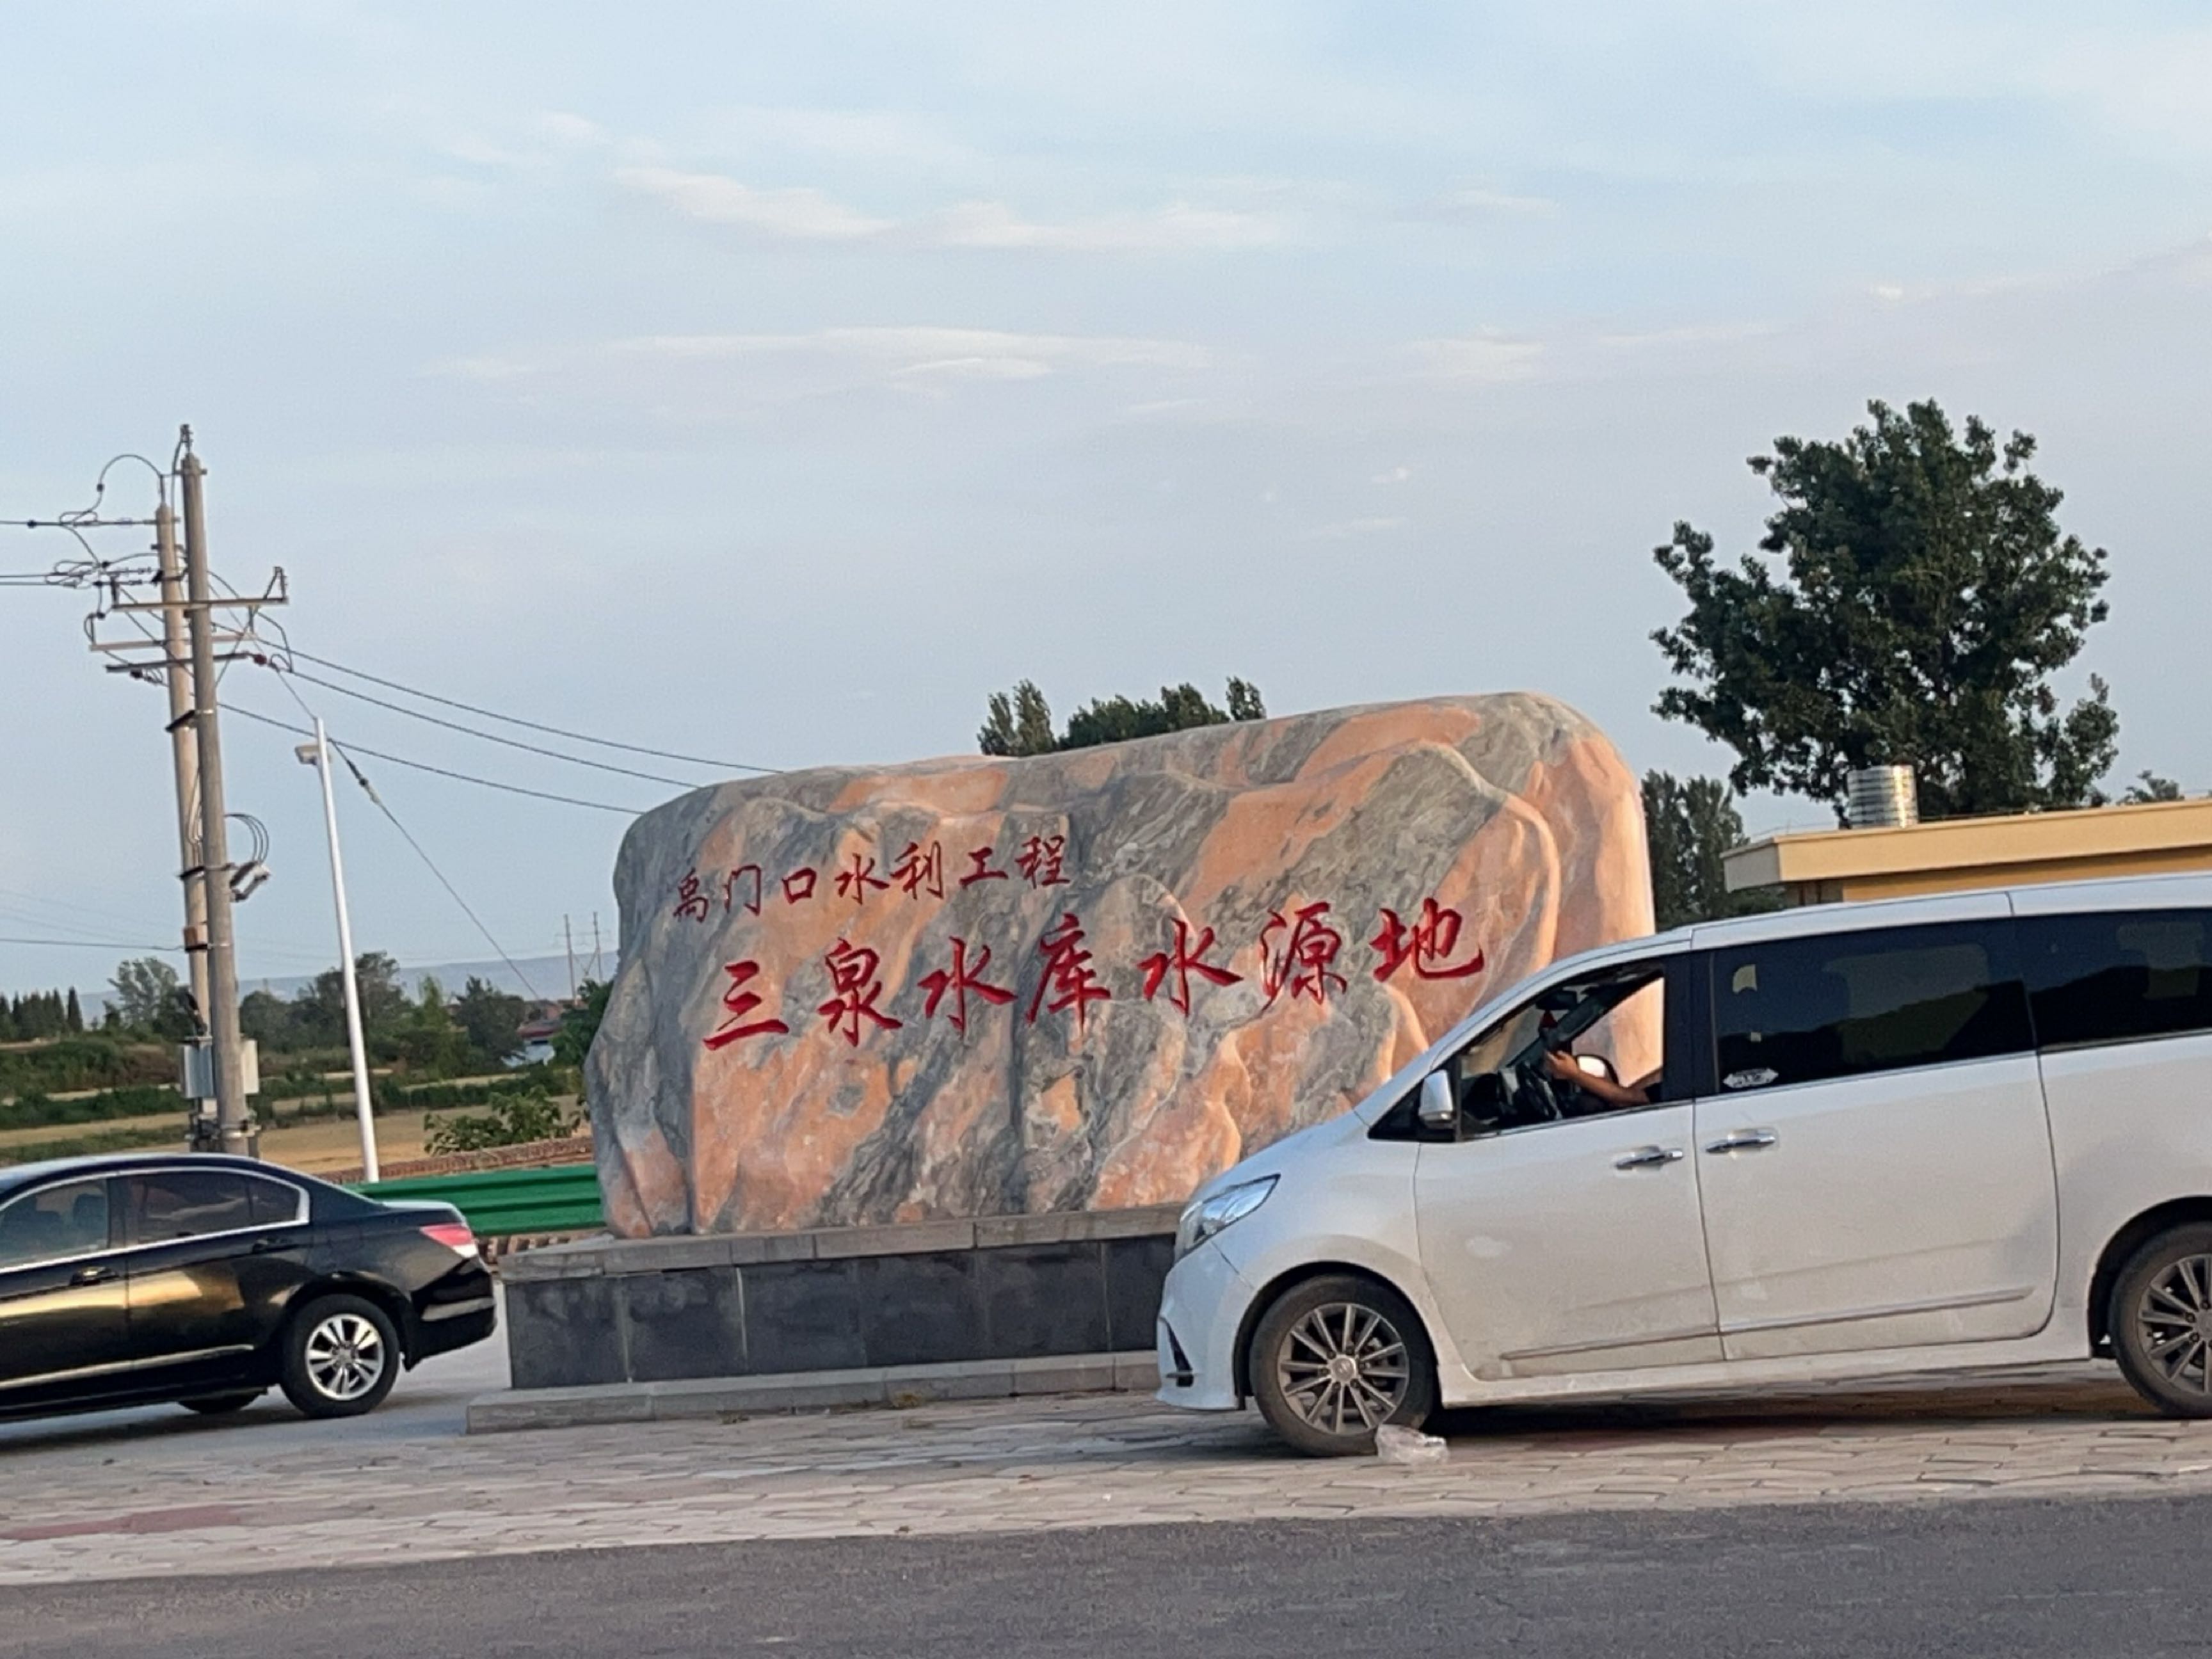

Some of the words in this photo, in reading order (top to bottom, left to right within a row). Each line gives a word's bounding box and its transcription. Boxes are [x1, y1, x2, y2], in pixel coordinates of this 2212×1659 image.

[673, 835, 1071, 922] 禹门口水利工程
[704, 900, 1483, 1051] 三泉水库水源地
